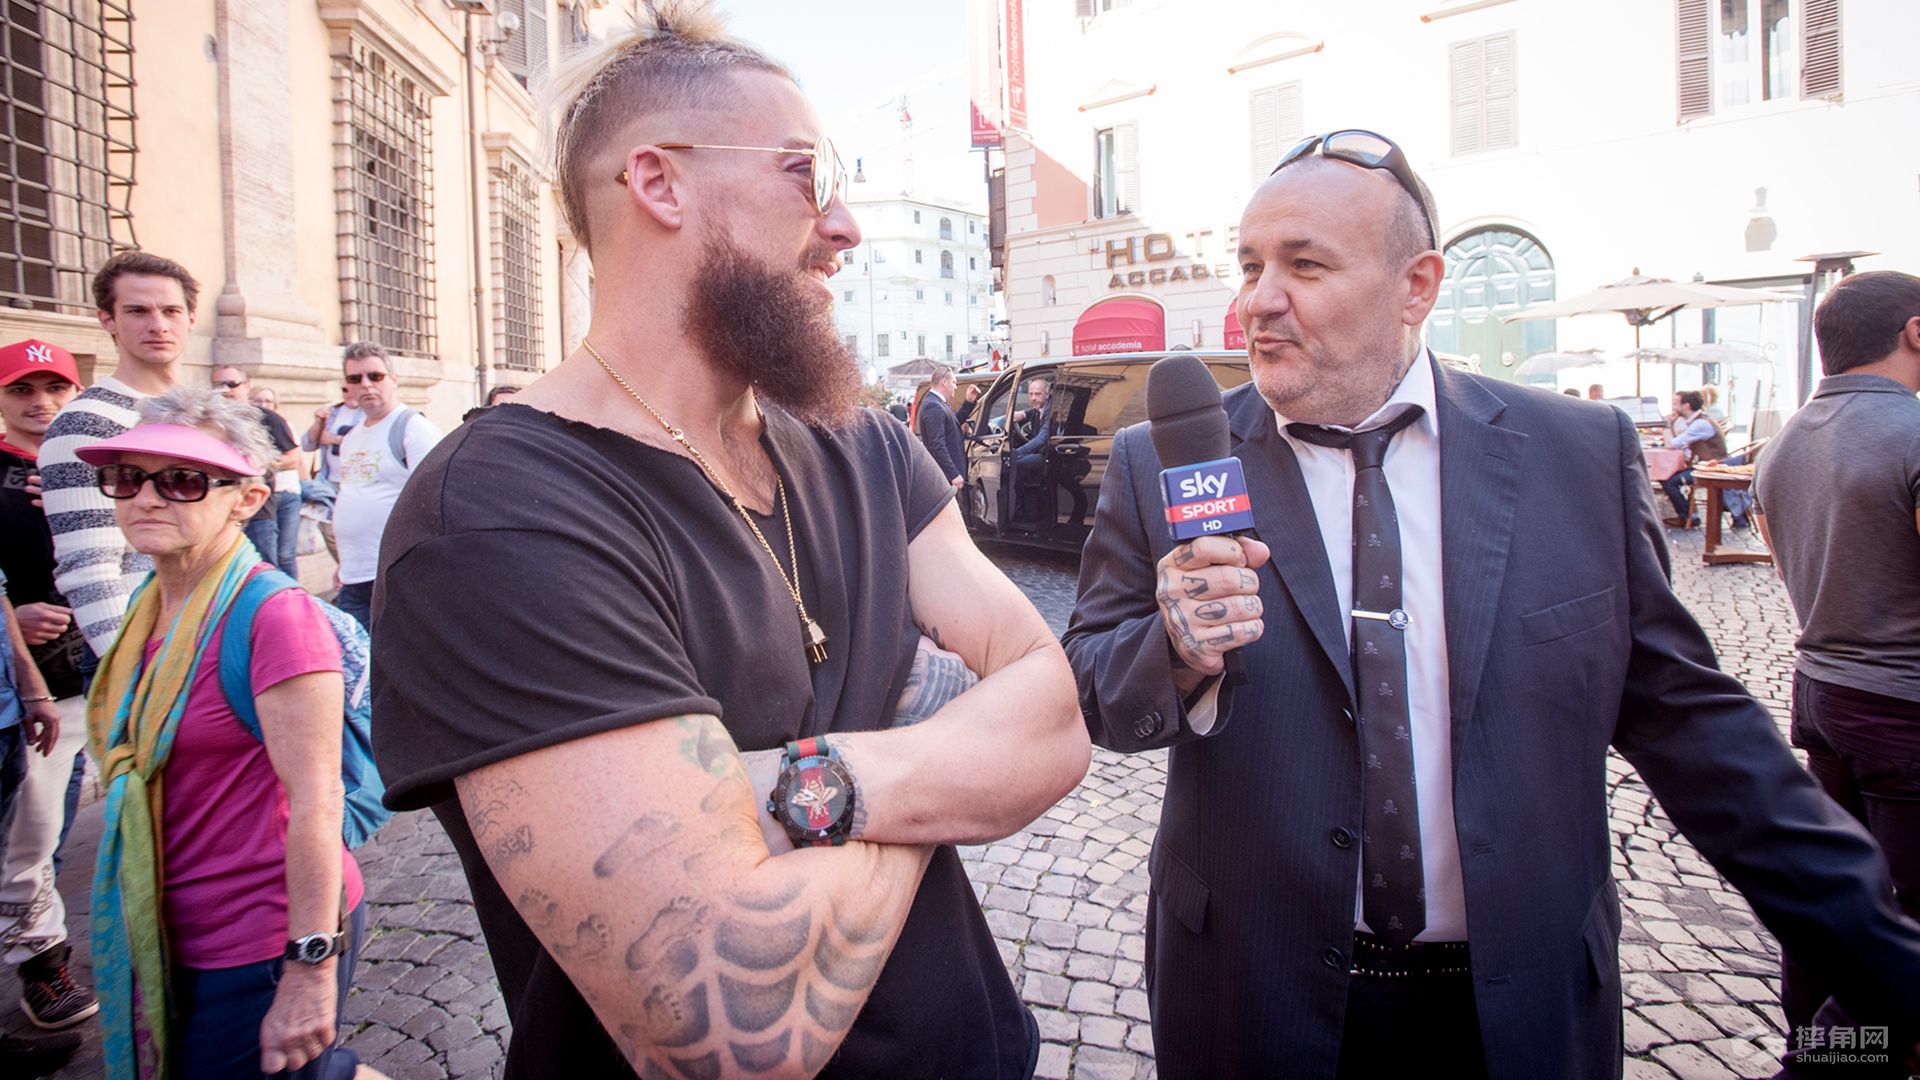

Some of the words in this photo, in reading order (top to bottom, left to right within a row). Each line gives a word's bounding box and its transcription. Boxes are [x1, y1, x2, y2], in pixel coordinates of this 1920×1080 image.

[1108, 262, 1241, 289] ACCADE
[25, 344, 53, 363] NY
[1098, 340, 1142, 350] accademia
[1180, 471, 1228, 498] sky
[1181, 498, 1236, 519] SPORT
[1202, 519, 1222, 532] HD
